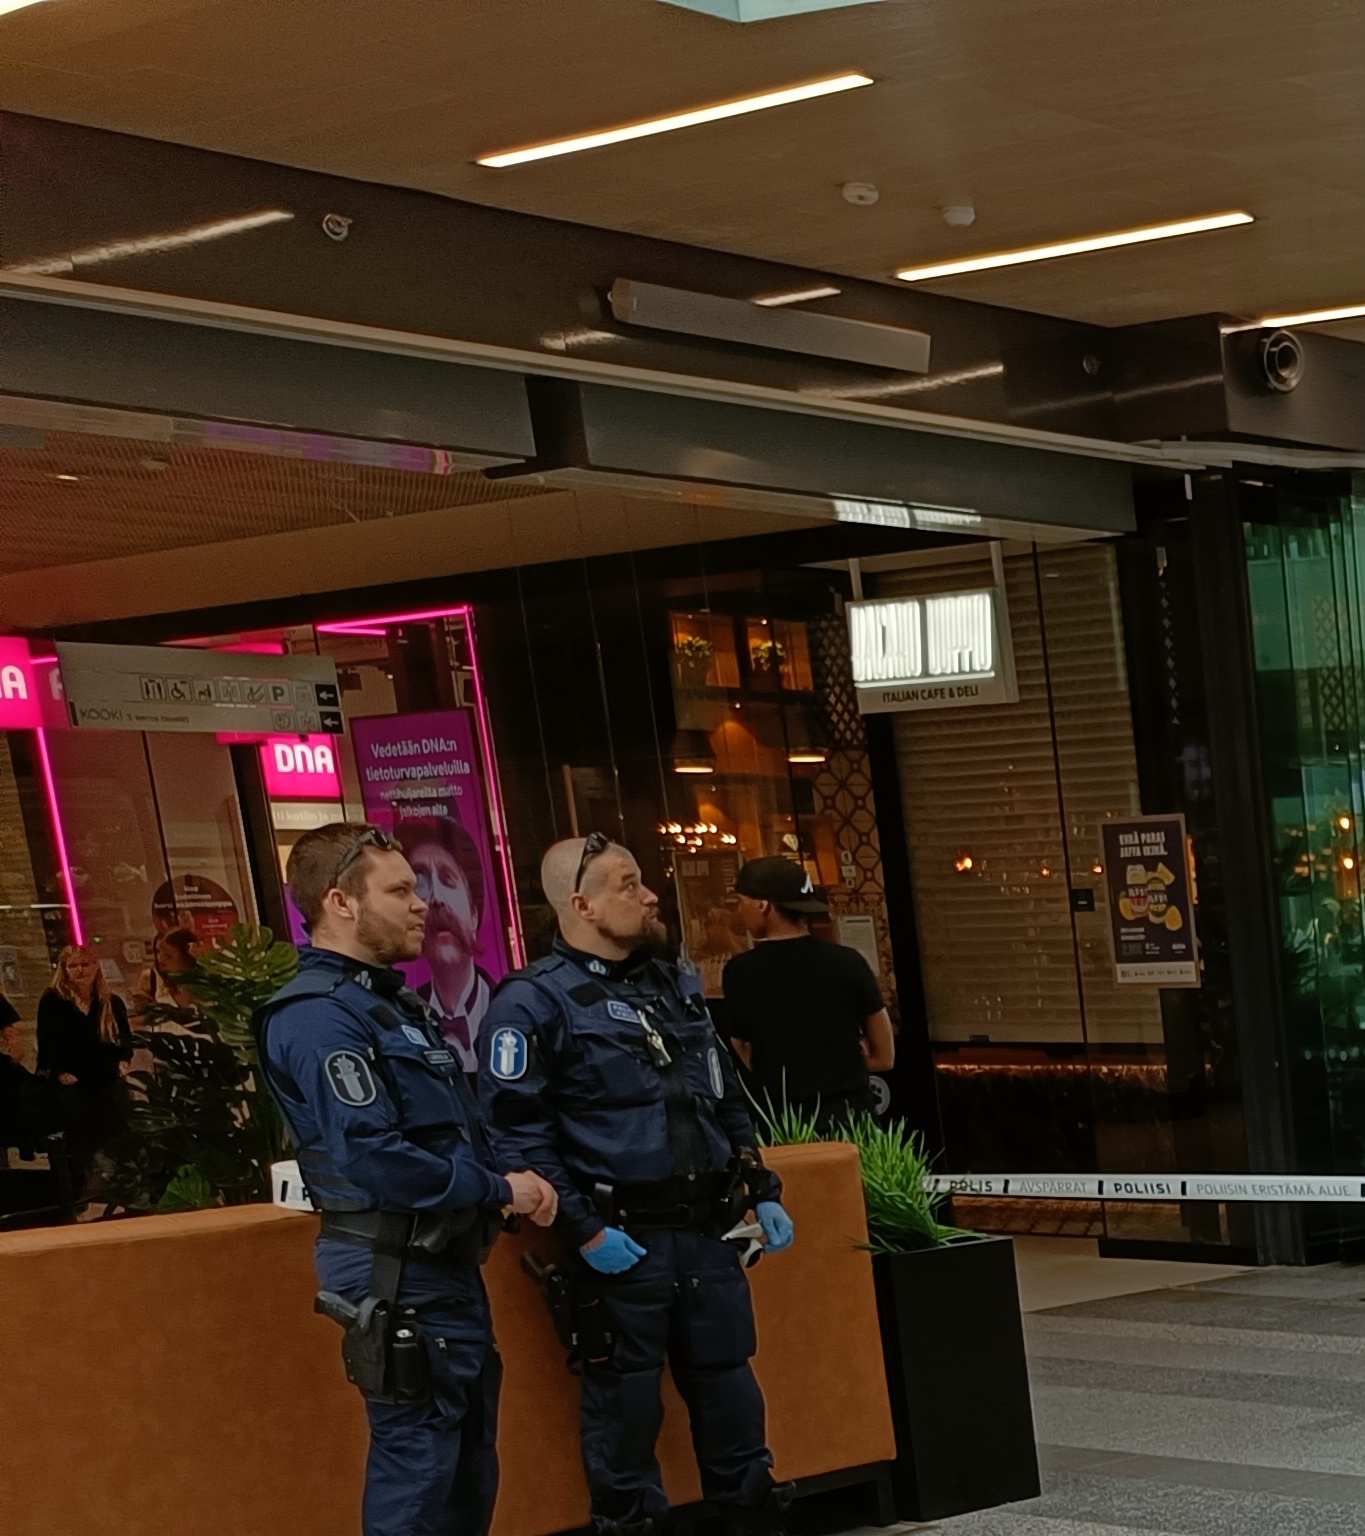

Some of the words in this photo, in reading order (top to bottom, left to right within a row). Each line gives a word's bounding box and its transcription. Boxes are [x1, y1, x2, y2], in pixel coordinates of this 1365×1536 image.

[883, 689, 919, 703] ITALIAN
[921, 687, 945, 700] CAFE
[958, 685, 979, 697] DELI
[371, 740, 421, 758] Vedetään
[422, 737, 457, 752] DNA:n
[274, 744, 335, 774] DNA
[366, 760, 470, 781] tietoturvapalveluilla
[1020, 1179, 1087, 1194] AVSPÄRRAT
[1114, 1182, 1171, 1195] POLIISI
[1196, 1182, 1248, 1196] POLIISIN
[1251, 1181, 1315, 1196] ERISTÄMÄ
[1318, 1184, 1351, 1197] ALUE
